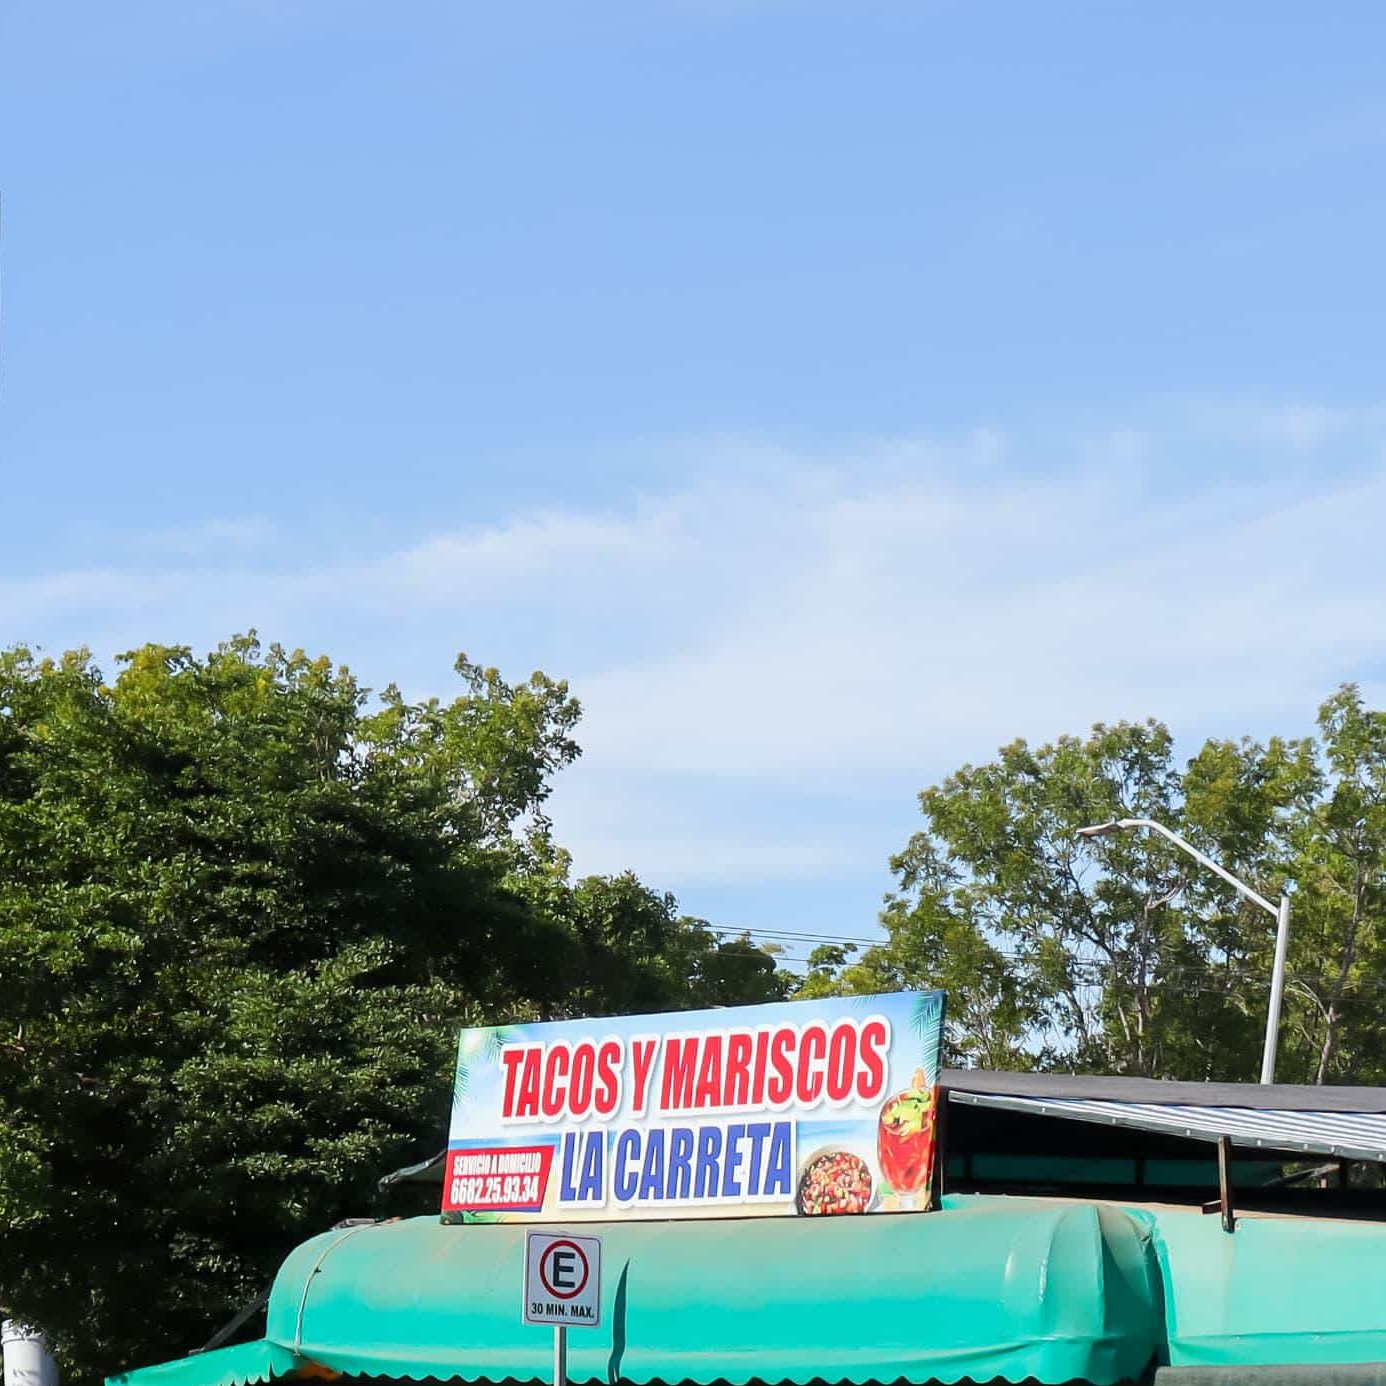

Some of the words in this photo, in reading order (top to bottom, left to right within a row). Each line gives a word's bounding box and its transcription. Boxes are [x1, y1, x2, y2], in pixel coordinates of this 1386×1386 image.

[502, 1041, 621, 1118] TACOS
[632, 1040, 656, 1111] Y
[660, 1021, 886, 1110] MARISCOS
[453, 1153, 491, 1176] SERVICIO
[498, 1152, 542, 1174] DOMICILIO
[559, 1130, 603, 1201] LA
[613, 1121, 792, 1202] CARRETA
[450, 1175, 540, 1204] 6682.25.93.34
[553, 1251, 576, 1288] E
[531, 1302, 543, 1314] 30
[546, 1303, 568, 1317] MIN.
[570, 1305, 595, 1319] MAX.
